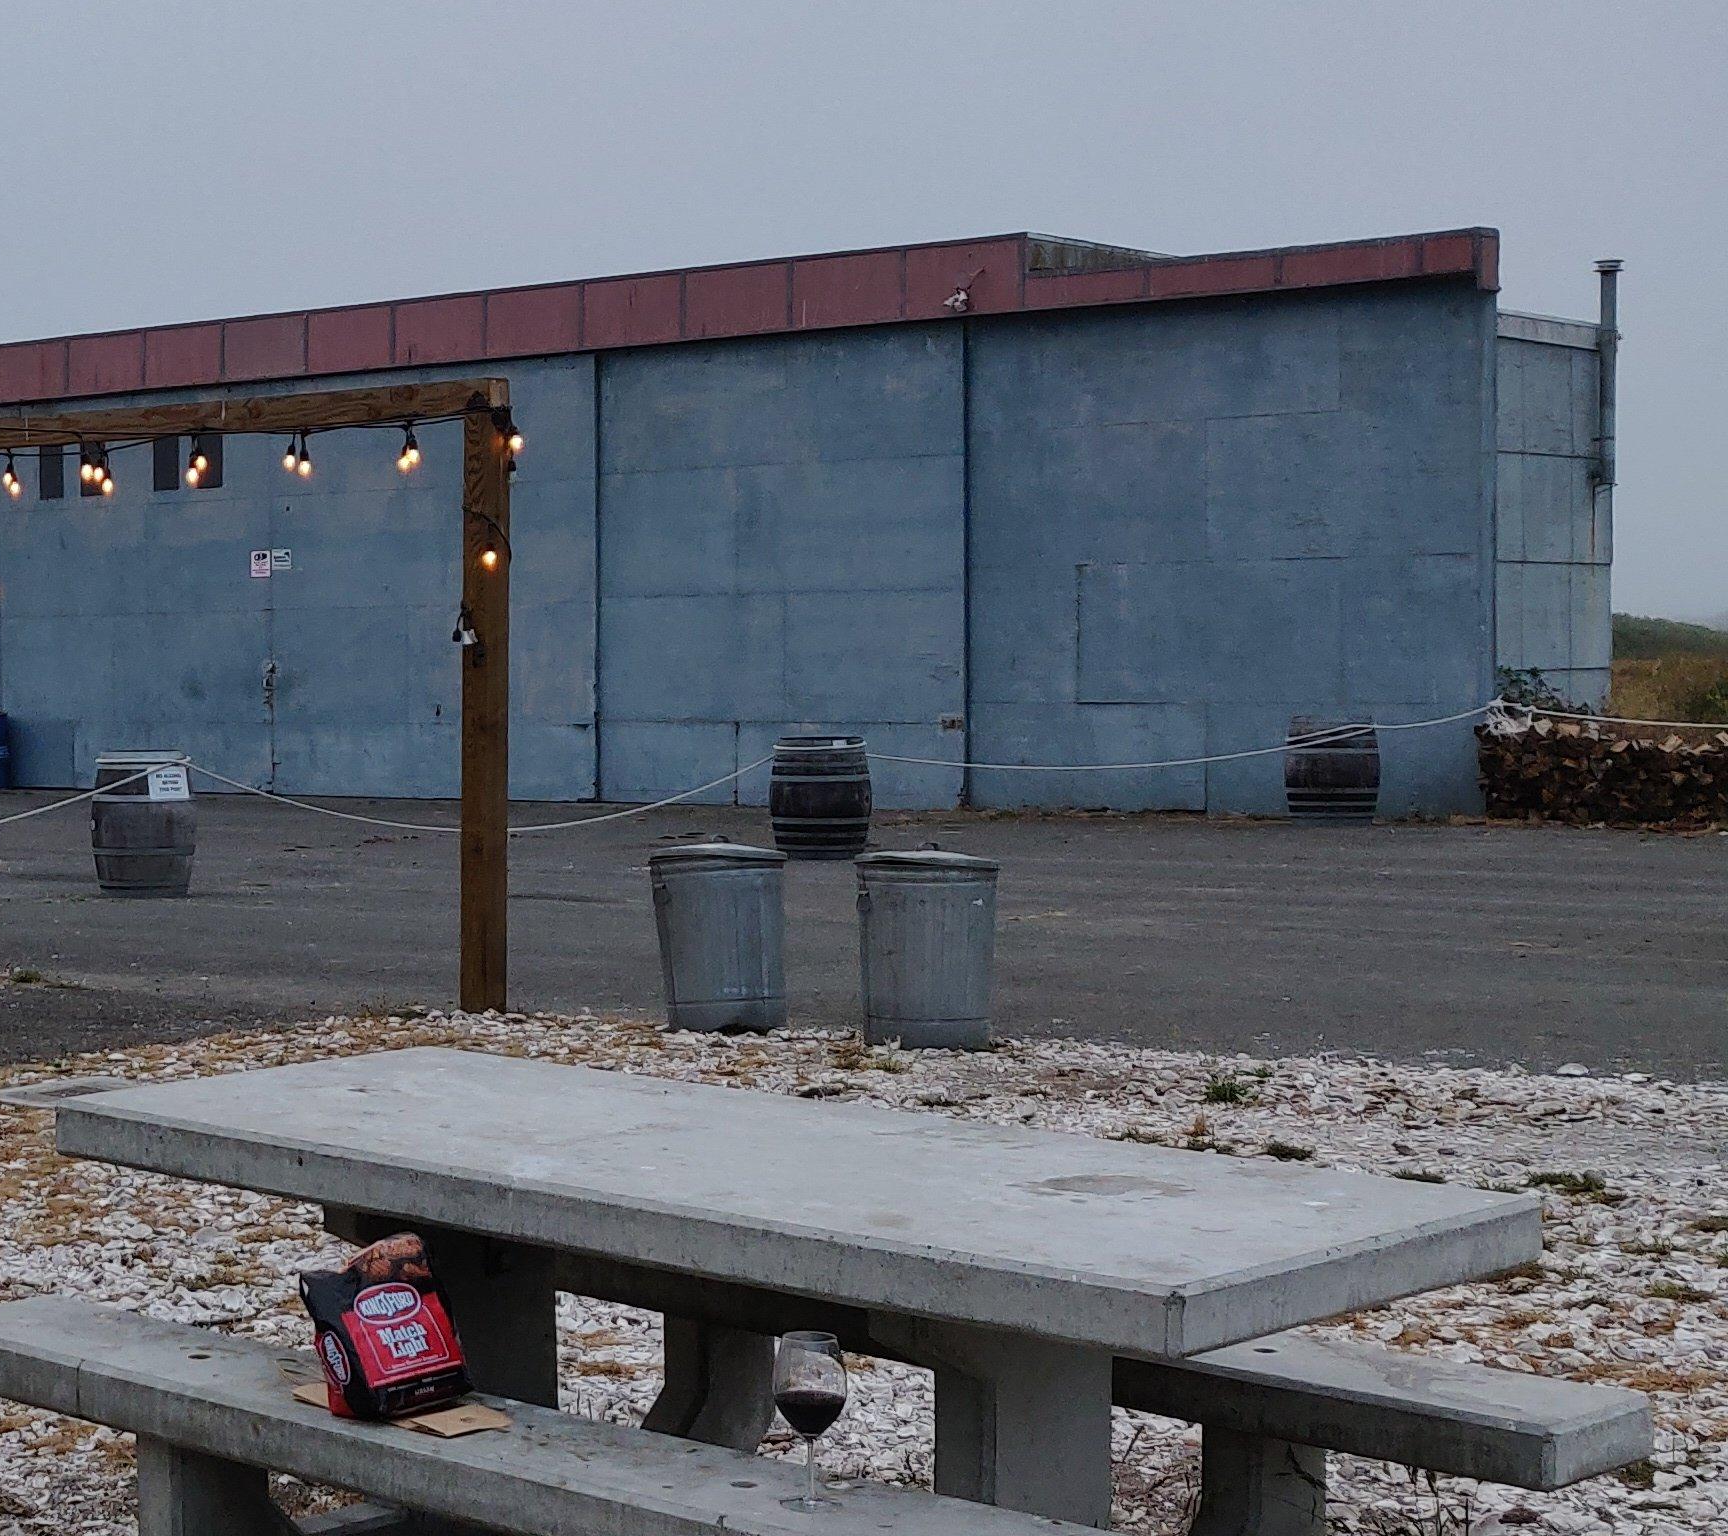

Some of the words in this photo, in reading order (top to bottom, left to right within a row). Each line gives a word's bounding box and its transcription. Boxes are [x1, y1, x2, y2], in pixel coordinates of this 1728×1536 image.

[358, 1291, 416, 1317] KINGSFORD
[376, 1321, 428, 1345] Match
[387, 1337, 430, 1359] Light
